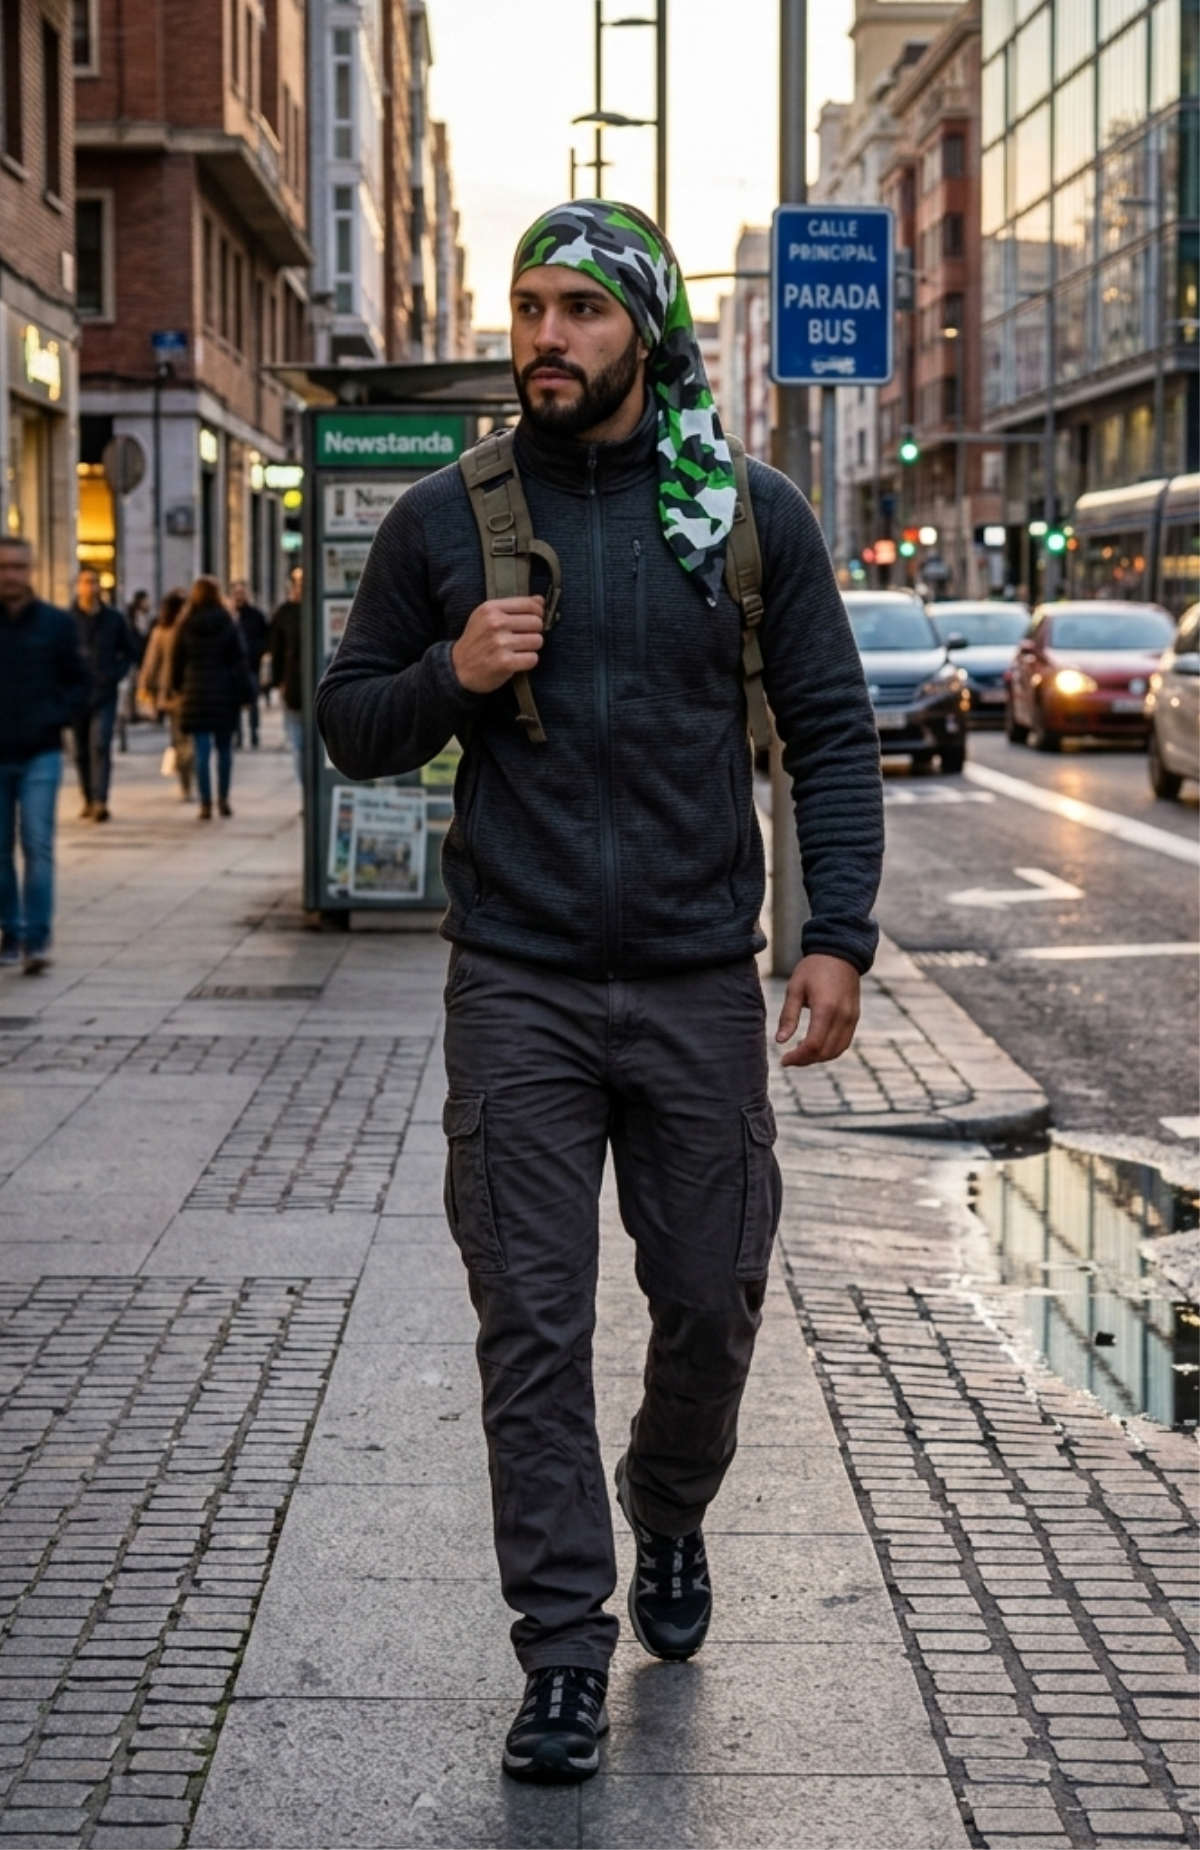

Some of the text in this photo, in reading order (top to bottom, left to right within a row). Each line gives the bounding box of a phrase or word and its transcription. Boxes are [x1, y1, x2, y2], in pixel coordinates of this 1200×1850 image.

[808, 220, 857, 237] CALLE
[789, 243, 877, 262] PRINCIPAL
[784, 284, 880, 309] PARADA
[808, 319, 857, 344] BUS
[324, 431, 454, 453] Newstanda
